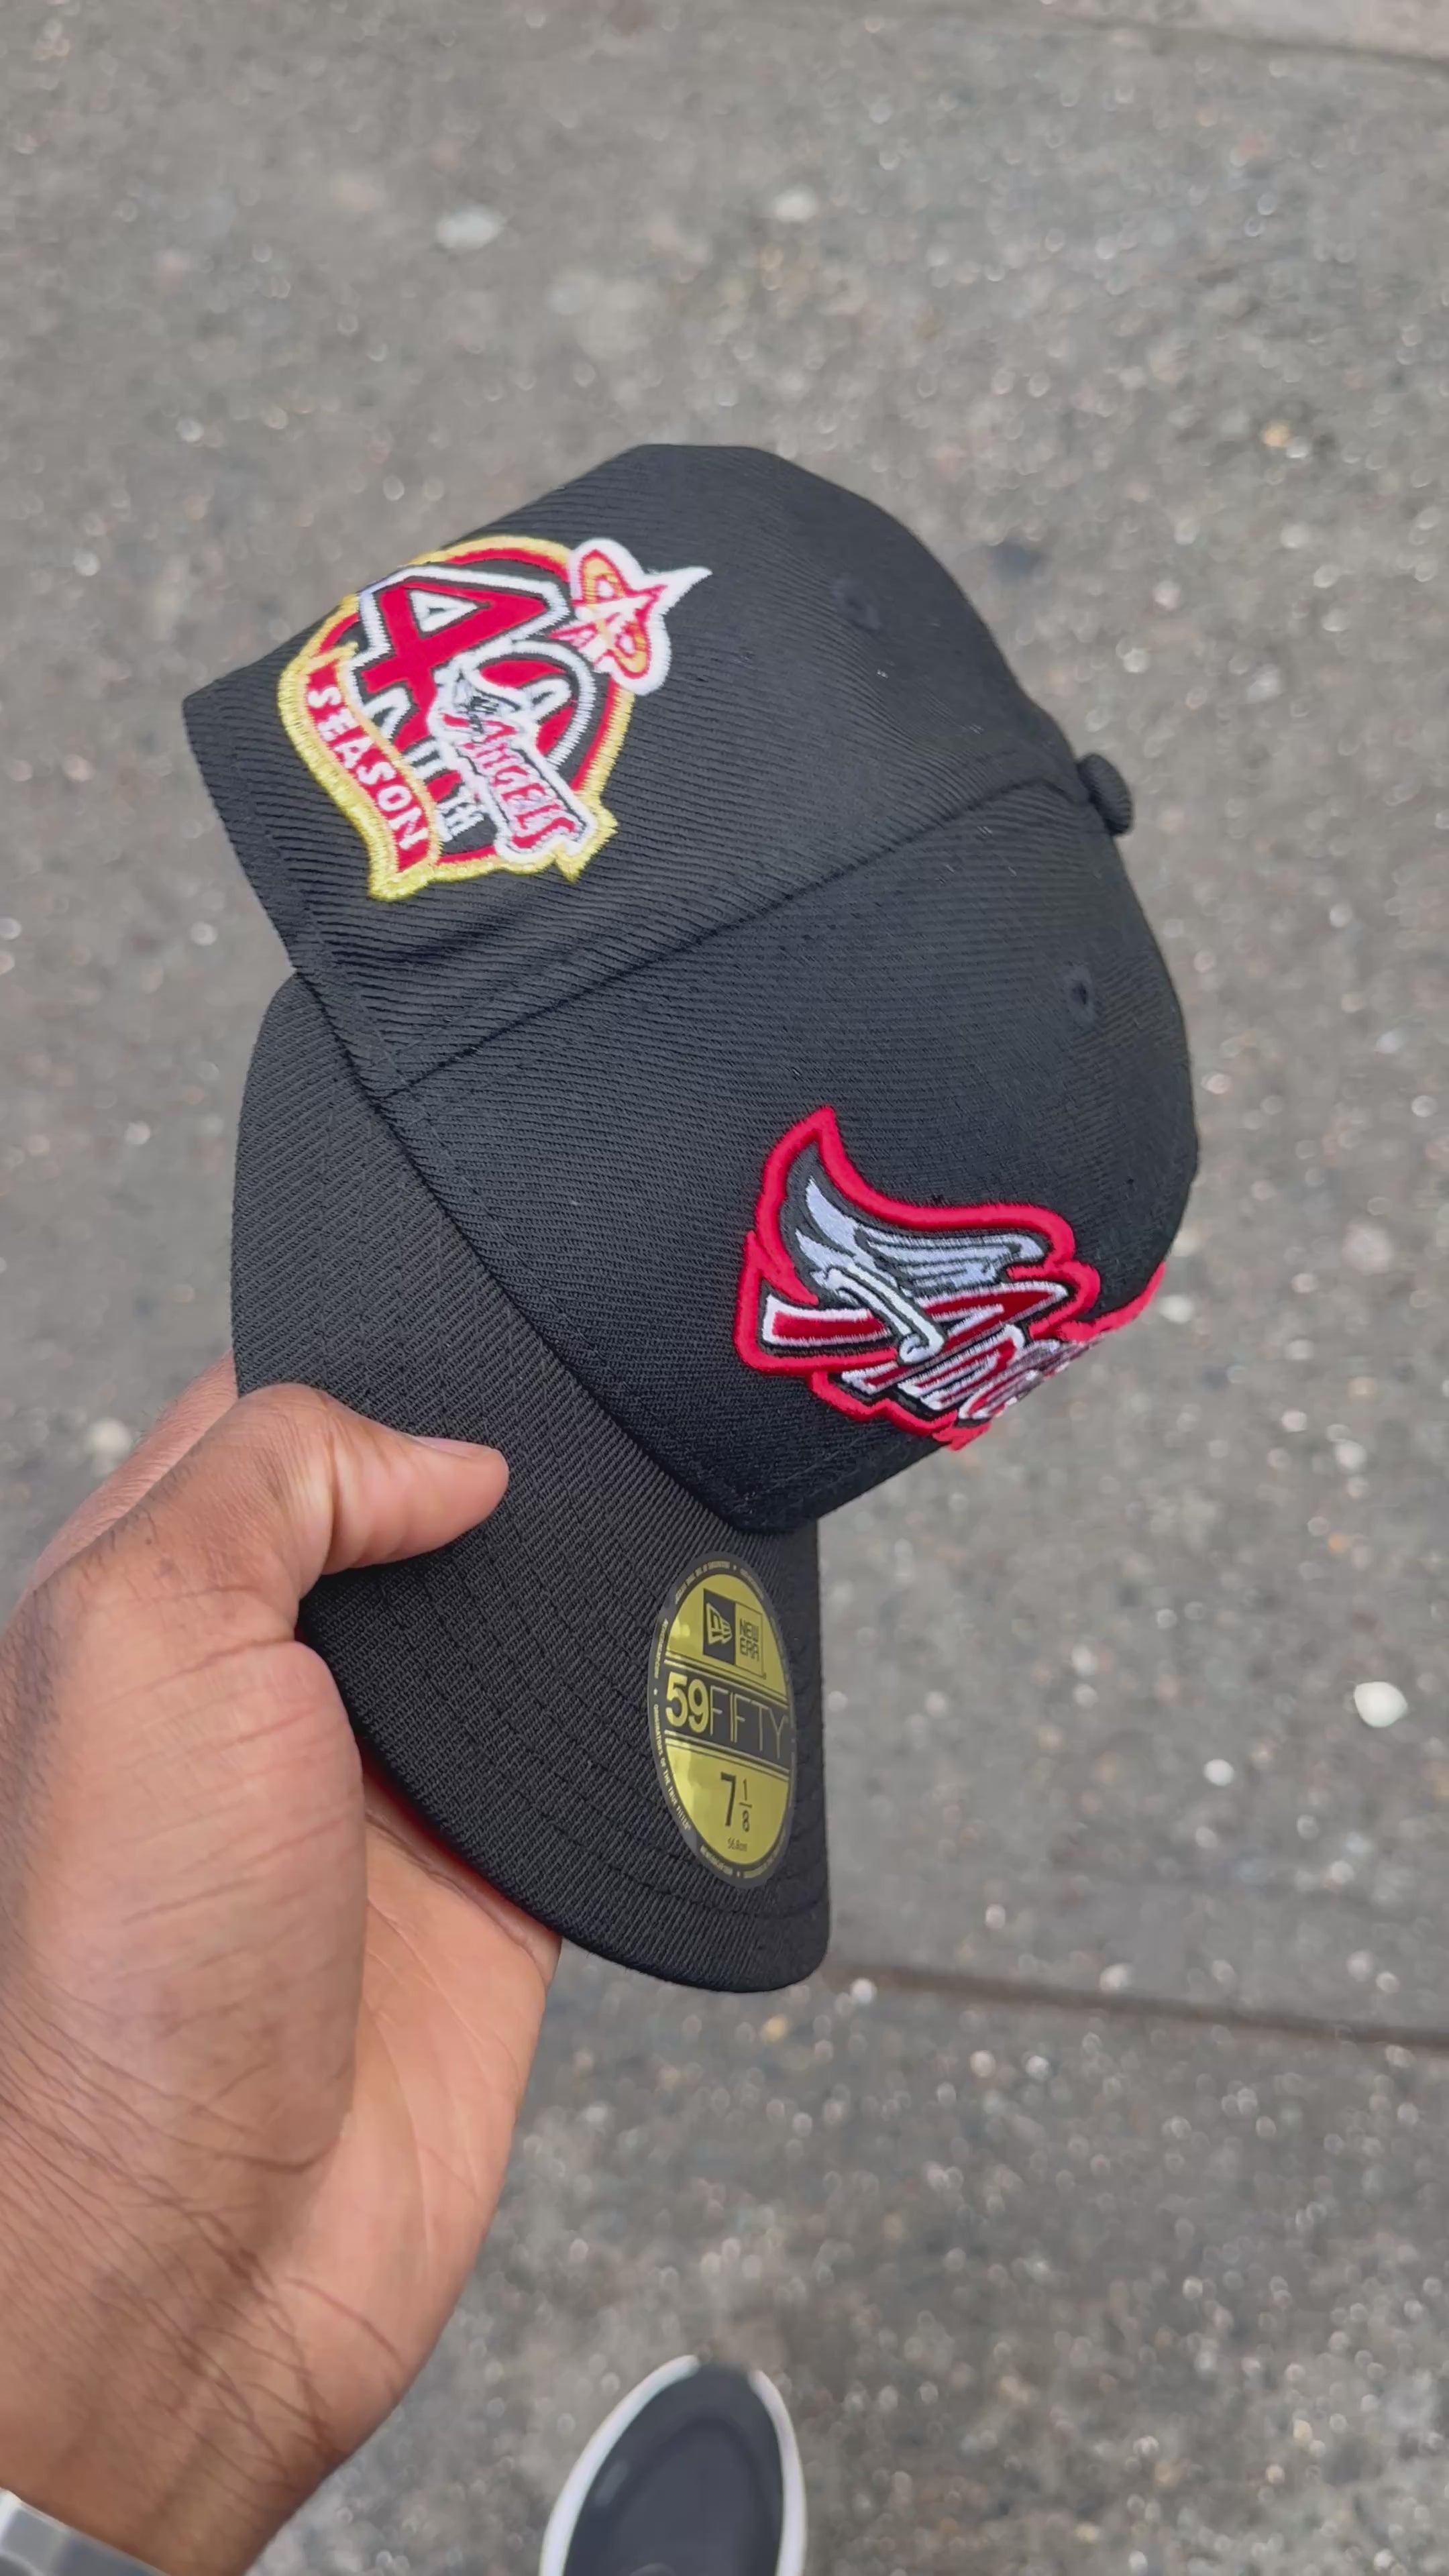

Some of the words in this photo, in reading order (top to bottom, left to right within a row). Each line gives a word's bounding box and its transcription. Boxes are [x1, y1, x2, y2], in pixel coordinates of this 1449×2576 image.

[307, 685, 429, 851] SEASON
[739, 1617, 760, 1643] NEW
[739, 1637, 760, 1662] ERA
[665, 1670, 789, 1760] 59FIFTY
